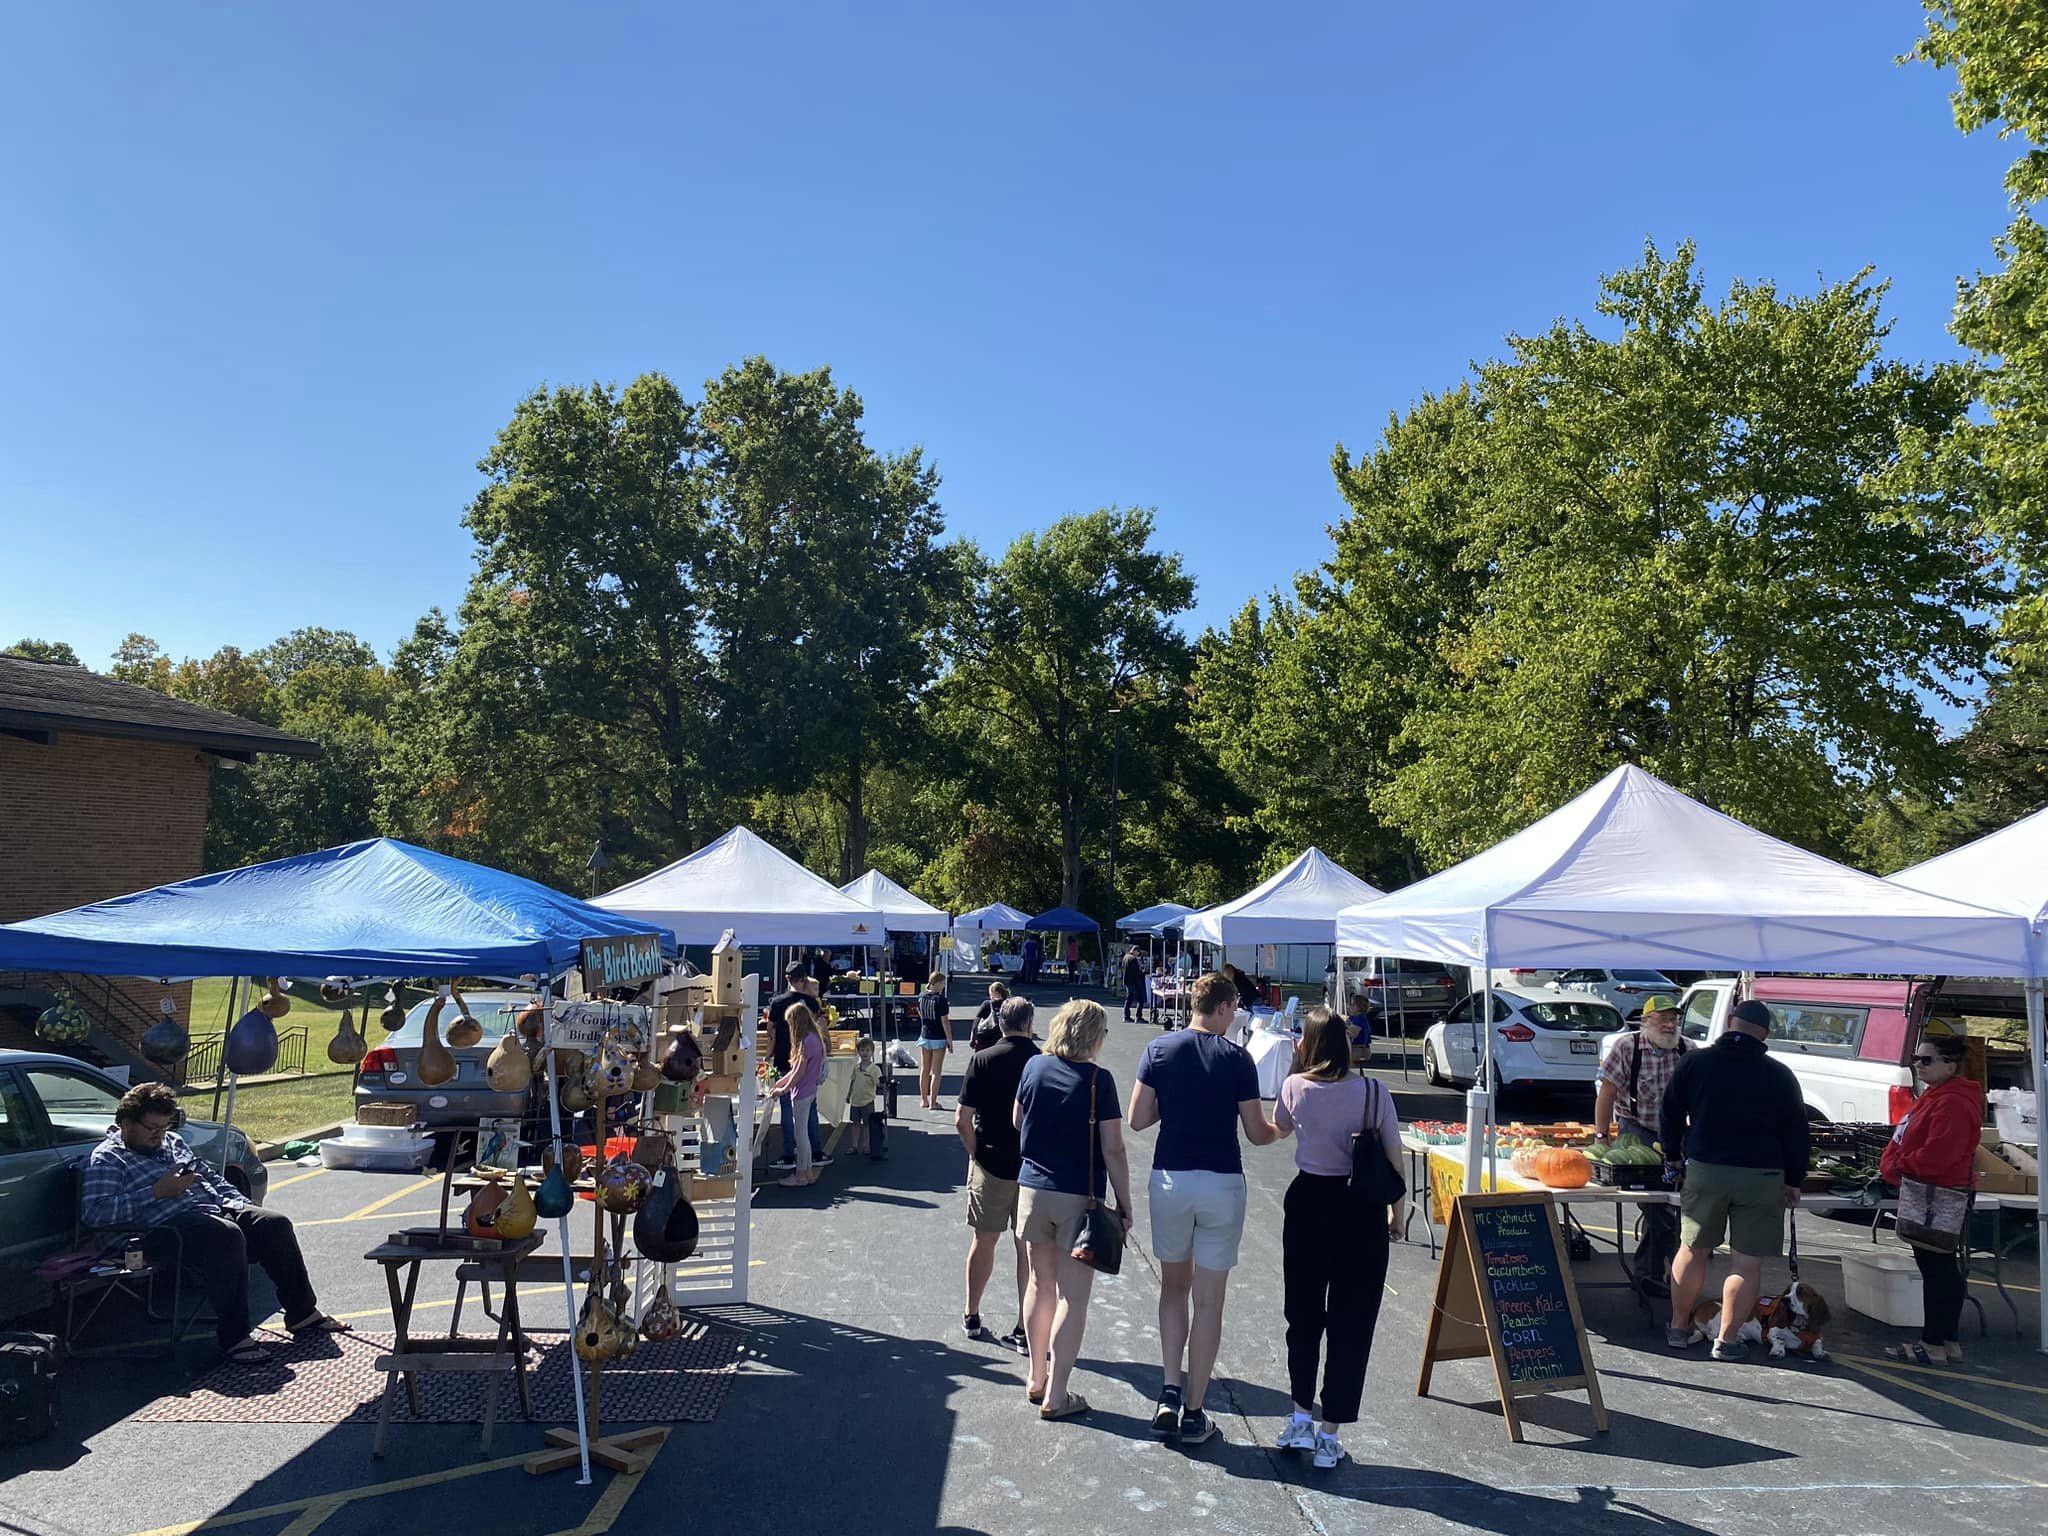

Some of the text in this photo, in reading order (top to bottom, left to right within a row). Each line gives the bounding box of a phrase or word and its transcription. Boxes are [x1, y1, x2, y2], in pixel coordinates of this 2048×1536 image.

[585, 939, 663, 984] The Bird Booth
[1496, 1208, 1537, 1225] Schmidt
[1502, 1313, 1548, 1329] Peaches
